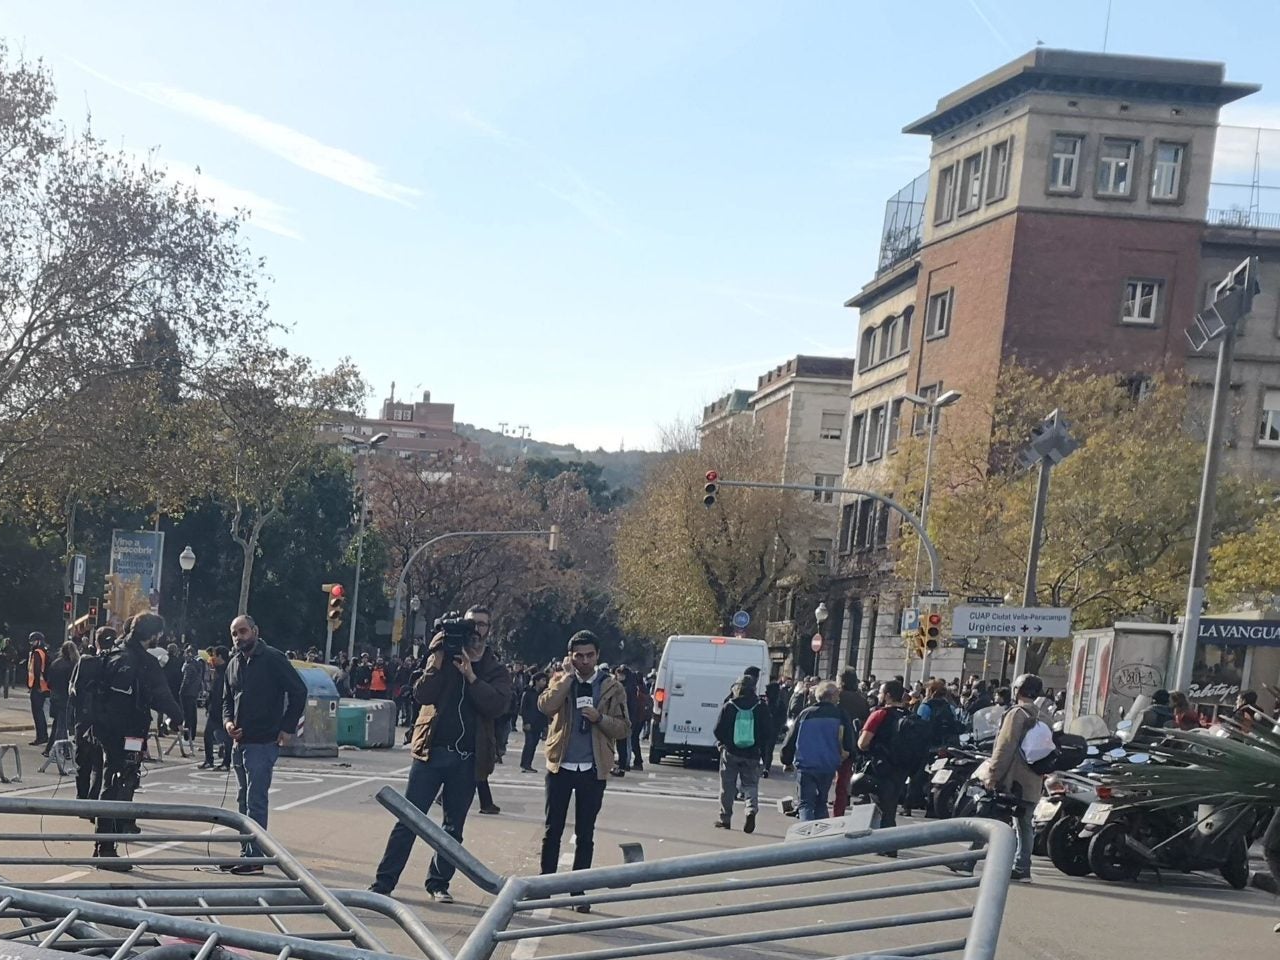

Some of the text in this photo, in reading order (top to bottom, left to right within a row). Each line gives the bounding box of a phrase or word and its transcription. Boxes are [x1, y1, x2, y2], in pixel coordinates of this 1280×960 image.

[969, 611, 991, 620] CUAP
[991, 613, 1011, 621] Ciutat
[968, 622, 1016, 634] Urgències
[1199, 624, 1218, 637] LA
